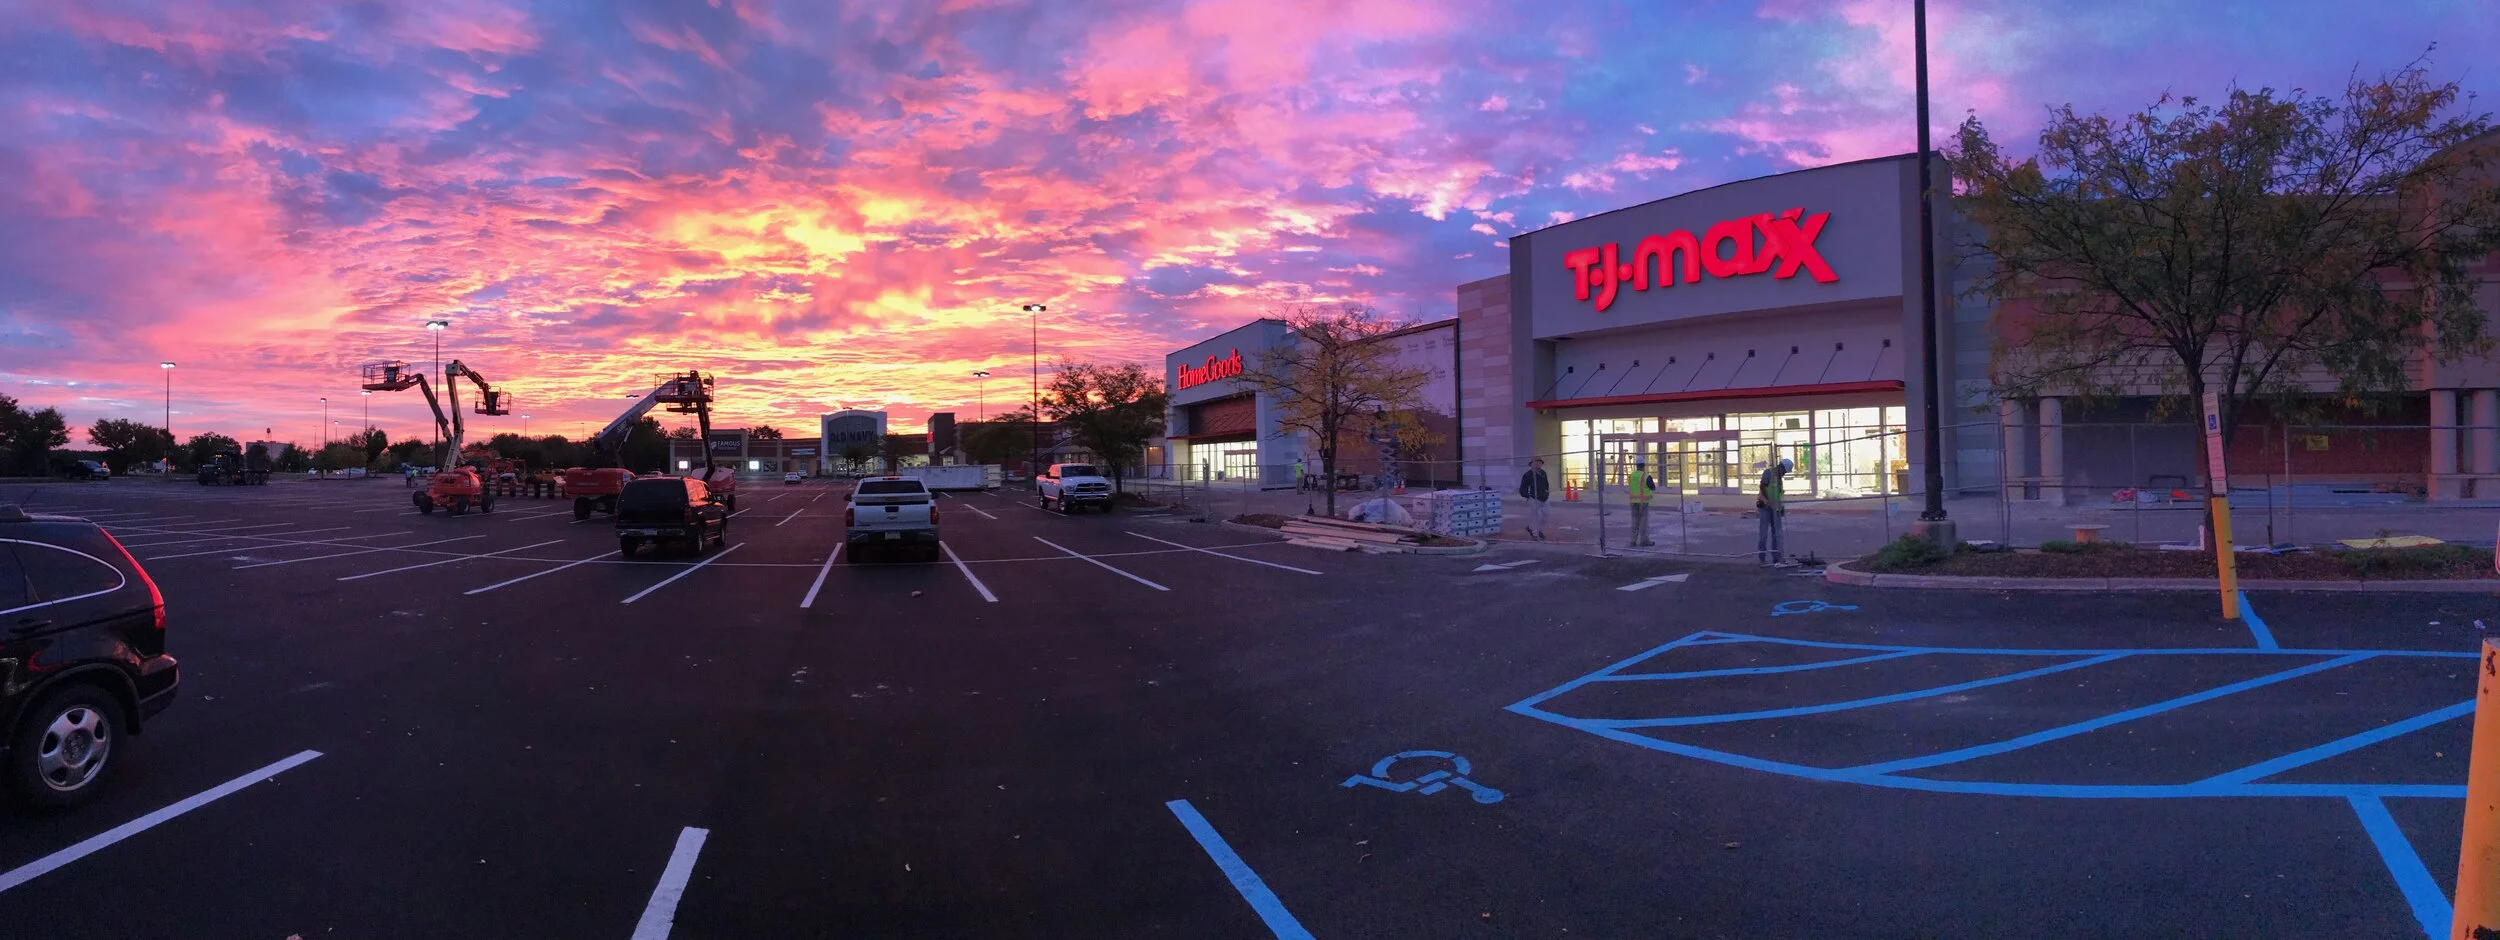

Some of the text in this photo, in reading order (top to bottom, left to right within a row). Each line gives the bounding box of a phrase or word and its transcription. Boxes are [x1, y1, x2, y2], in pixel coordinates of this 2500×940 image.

[1177, 348, 1243, 391] HomeGoods
[830, 430, 874, 442] OLD NAVY
